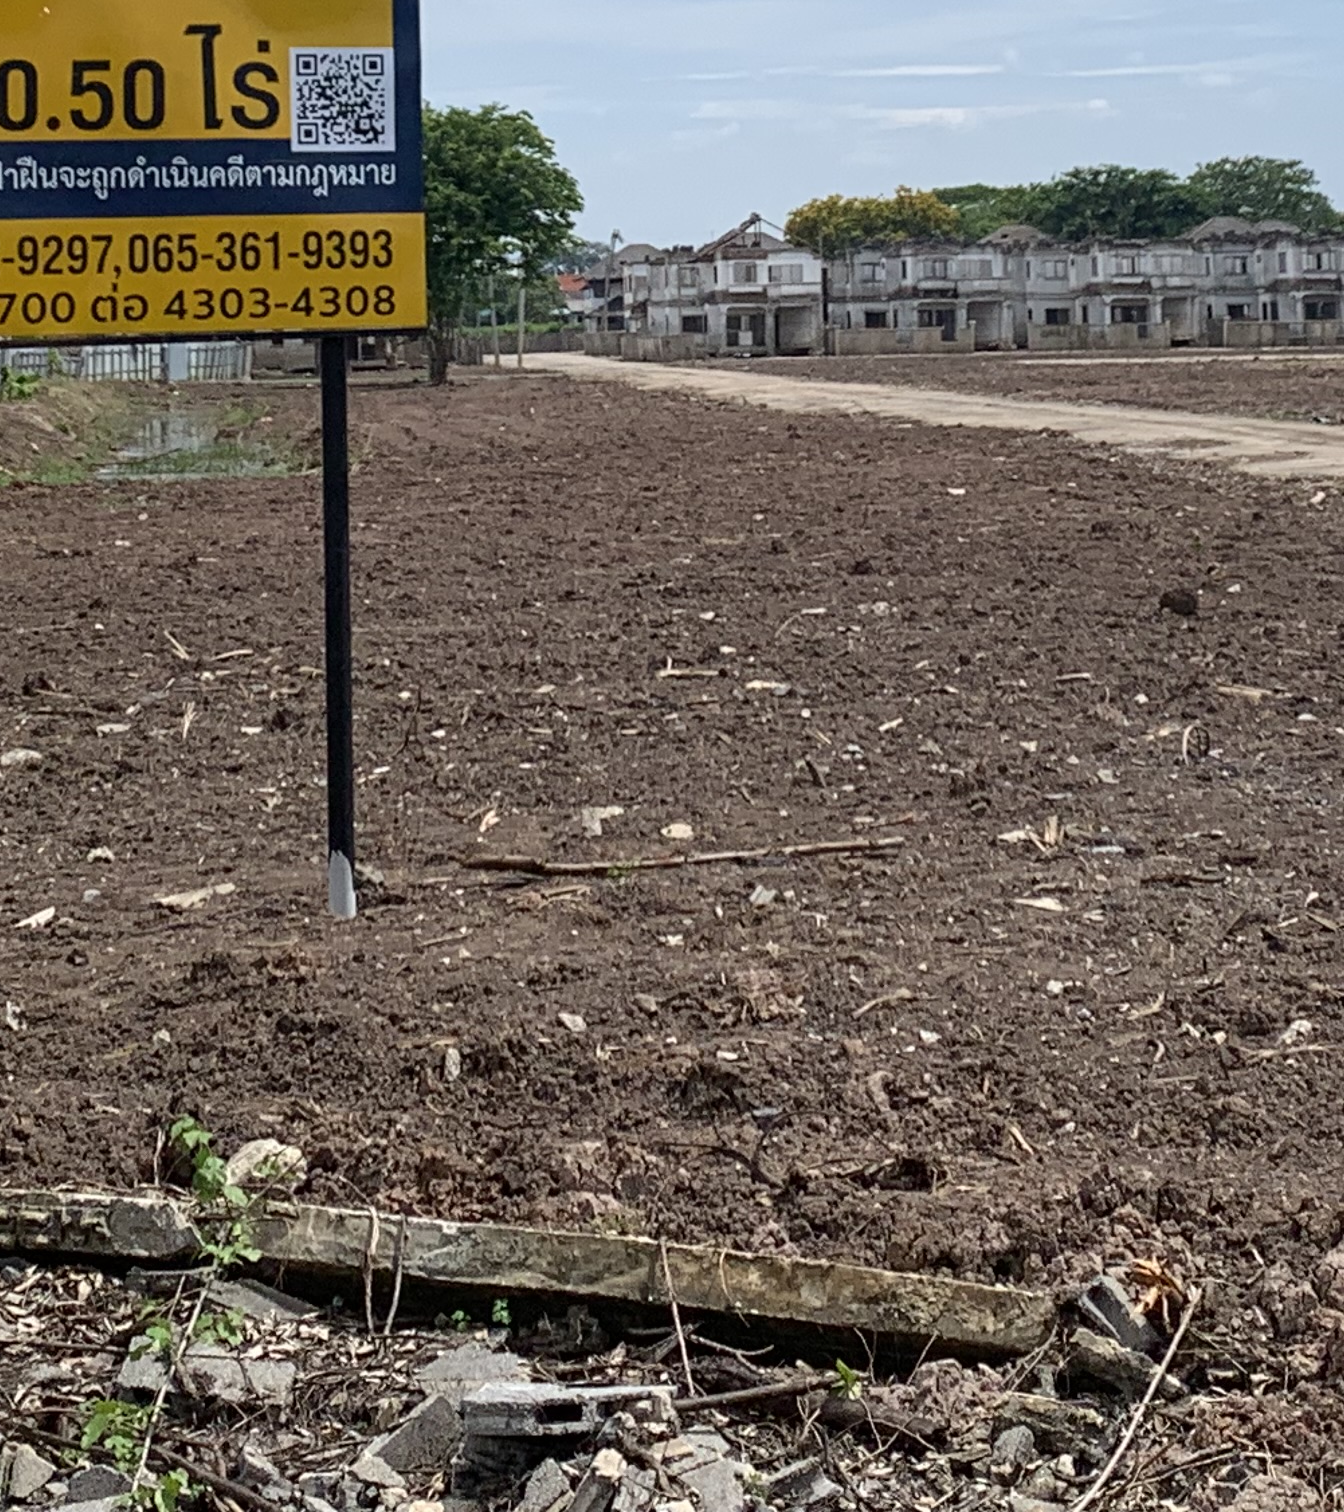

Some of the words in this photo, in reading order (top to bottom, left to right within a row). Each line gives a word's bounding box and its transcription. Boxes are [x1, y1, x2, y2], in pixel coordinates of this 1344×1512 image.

[184, 24, 281, 132] ไร่
[90, 283, 149, 323] ต่อ
[164, 285, 396, 320] 4303-4308
